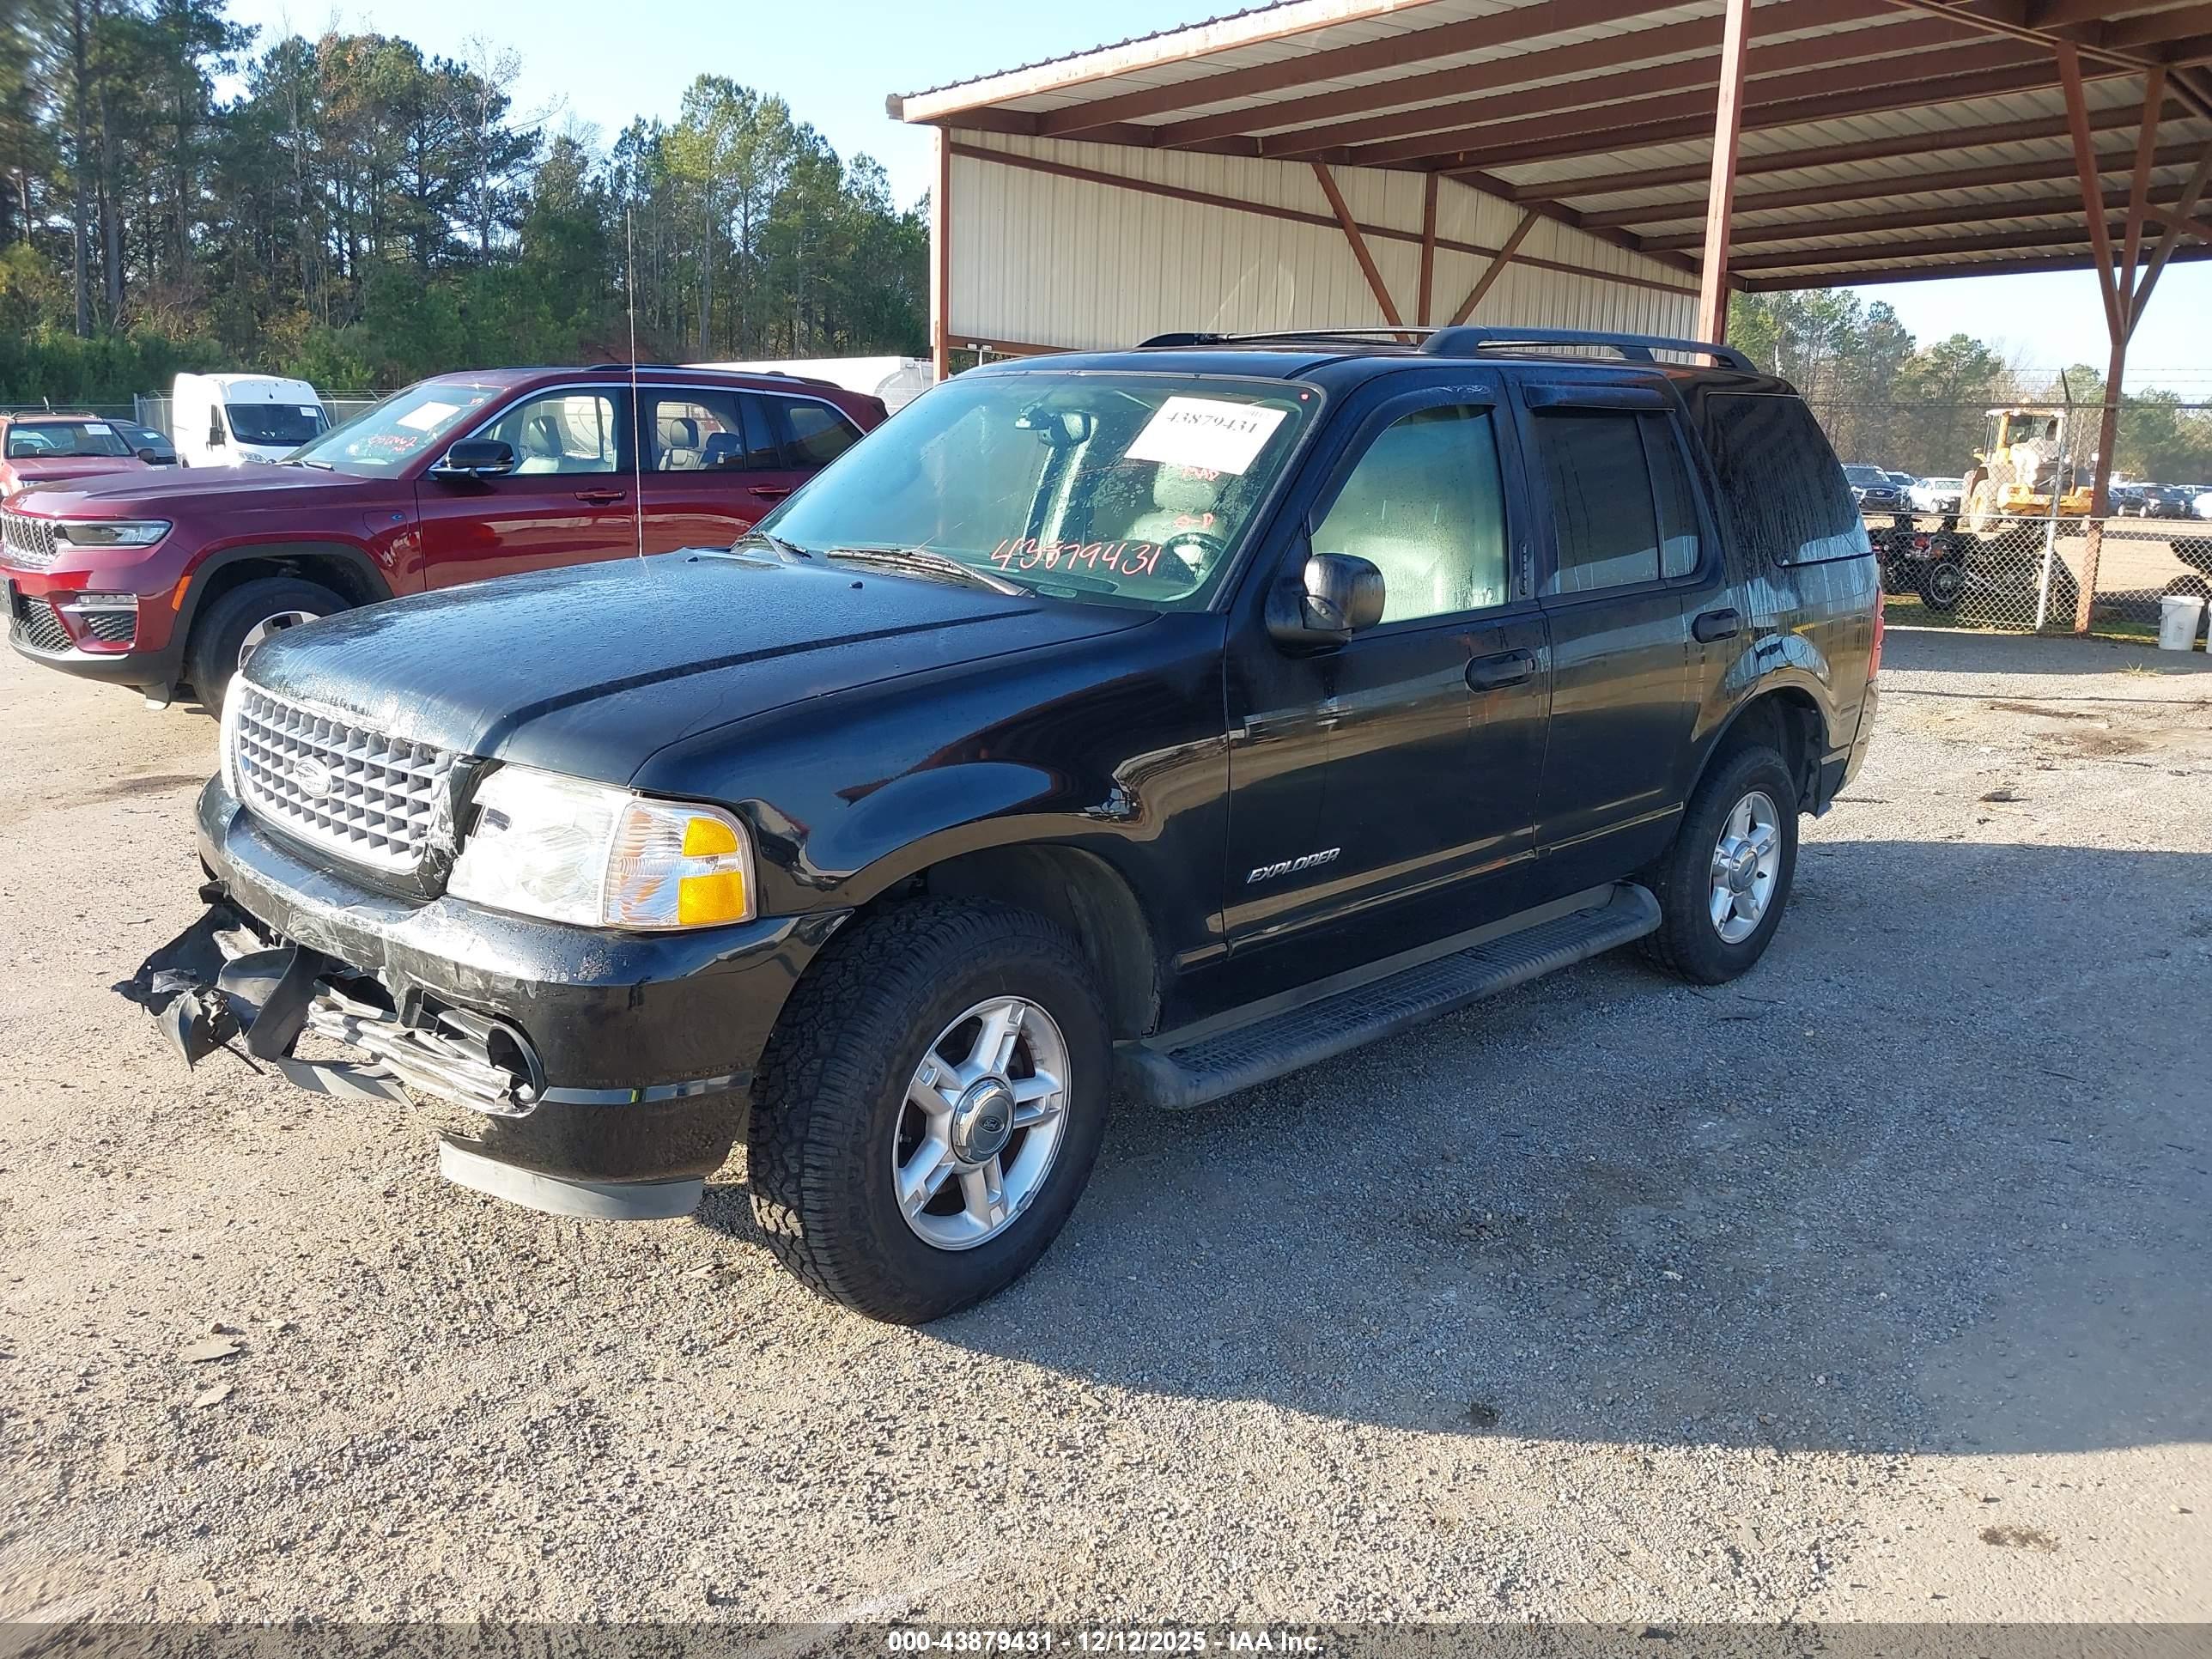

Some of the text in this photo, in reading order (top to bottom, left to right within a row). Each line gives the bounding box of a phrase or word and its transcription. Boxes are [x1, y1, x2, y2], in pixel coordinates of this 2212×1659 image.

[1167, 411, 1258, 434] 43879431
[990, 537, 1163, 575] 43879431
[1246, 847, 1340, 884] EXPLORER
